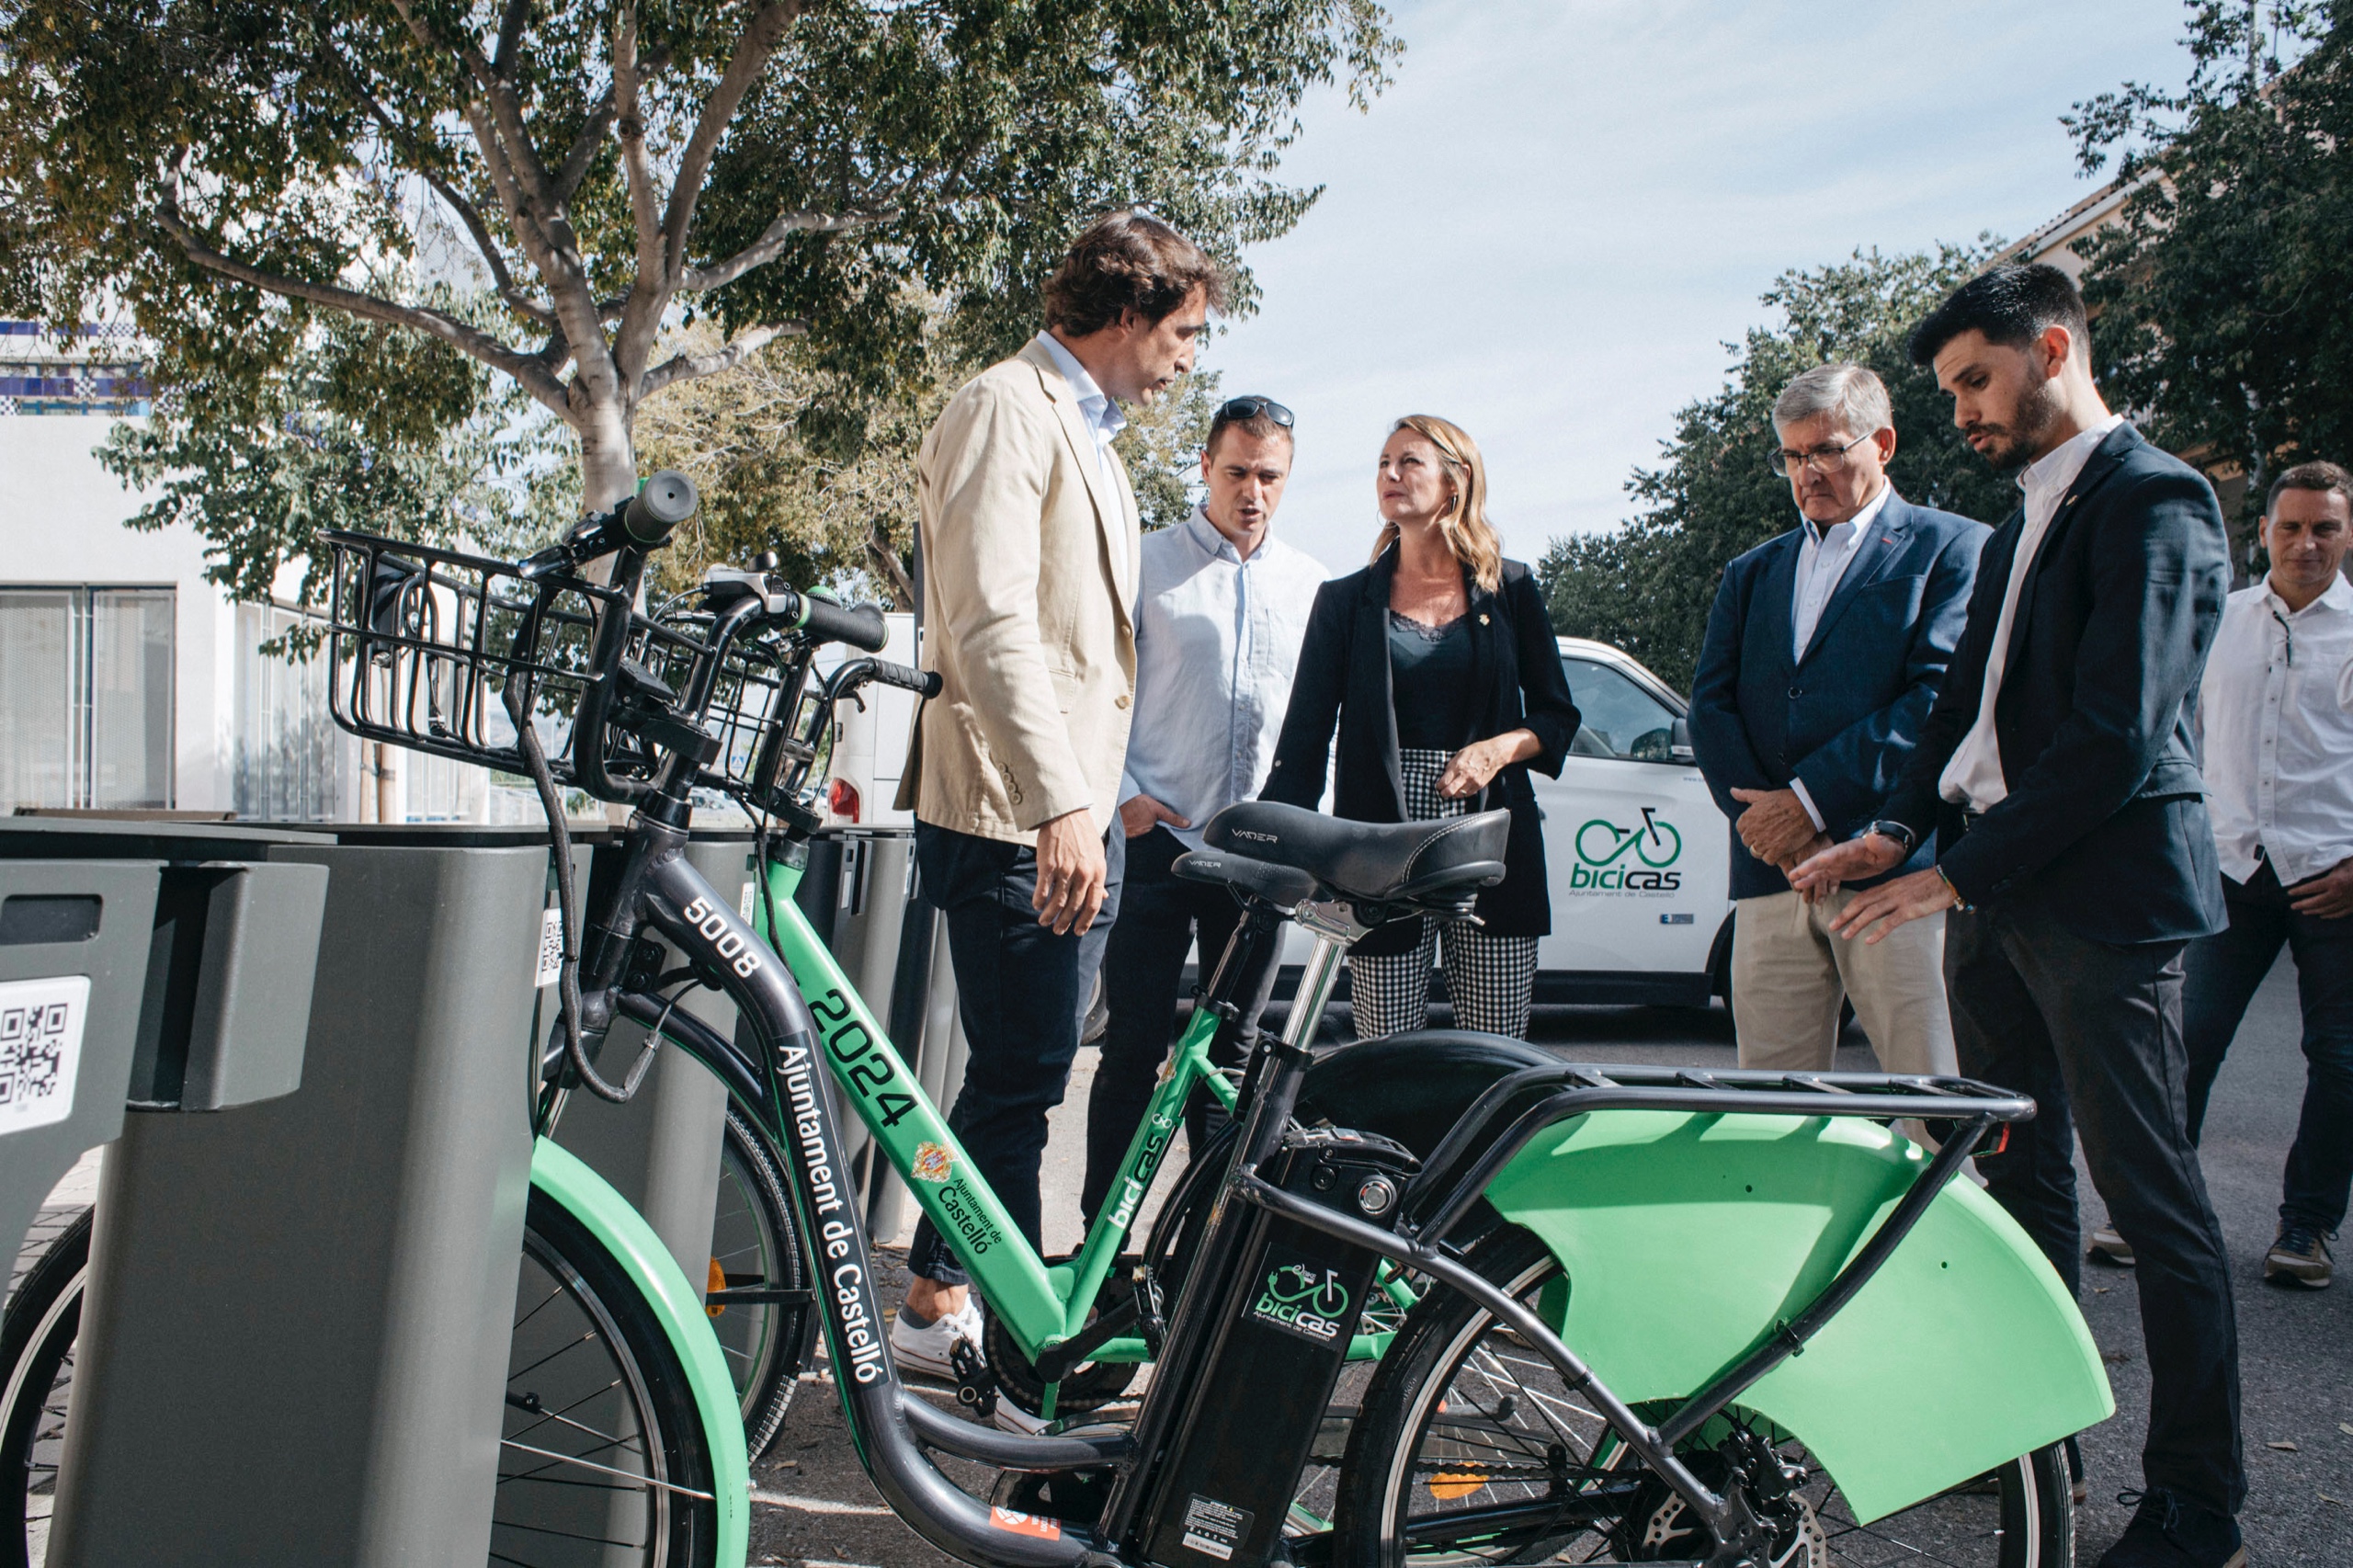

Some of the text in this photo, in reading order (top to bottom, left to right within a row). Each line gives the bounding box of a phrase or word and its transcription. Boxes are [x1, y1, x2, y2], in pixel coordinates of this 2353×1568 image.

[1188, 859, 1222, 869] VADER
[1232, 828, 1278, 844] VADER
[1568, 889, 1621, 898] Ajuntament
[1570, 862, 1681, 891] bicicas
[684, 895, 762, 978] 5008
[808, 988, 919, 1129] 2024
[1108, 1132, 1165, 1230] bicicas
[776, 1045, 884, 1384] Ajuntament de Castelló
[938, 1186, 992, 1255] Castelló
[953, 1178, 1002, 1244] Ajuntament de
[1253, 1310, 1292, 1329] Ajuntament
[1292, 1324, 1302, 1332] de
[1255, 1291, 1341, 1338] bicicas
